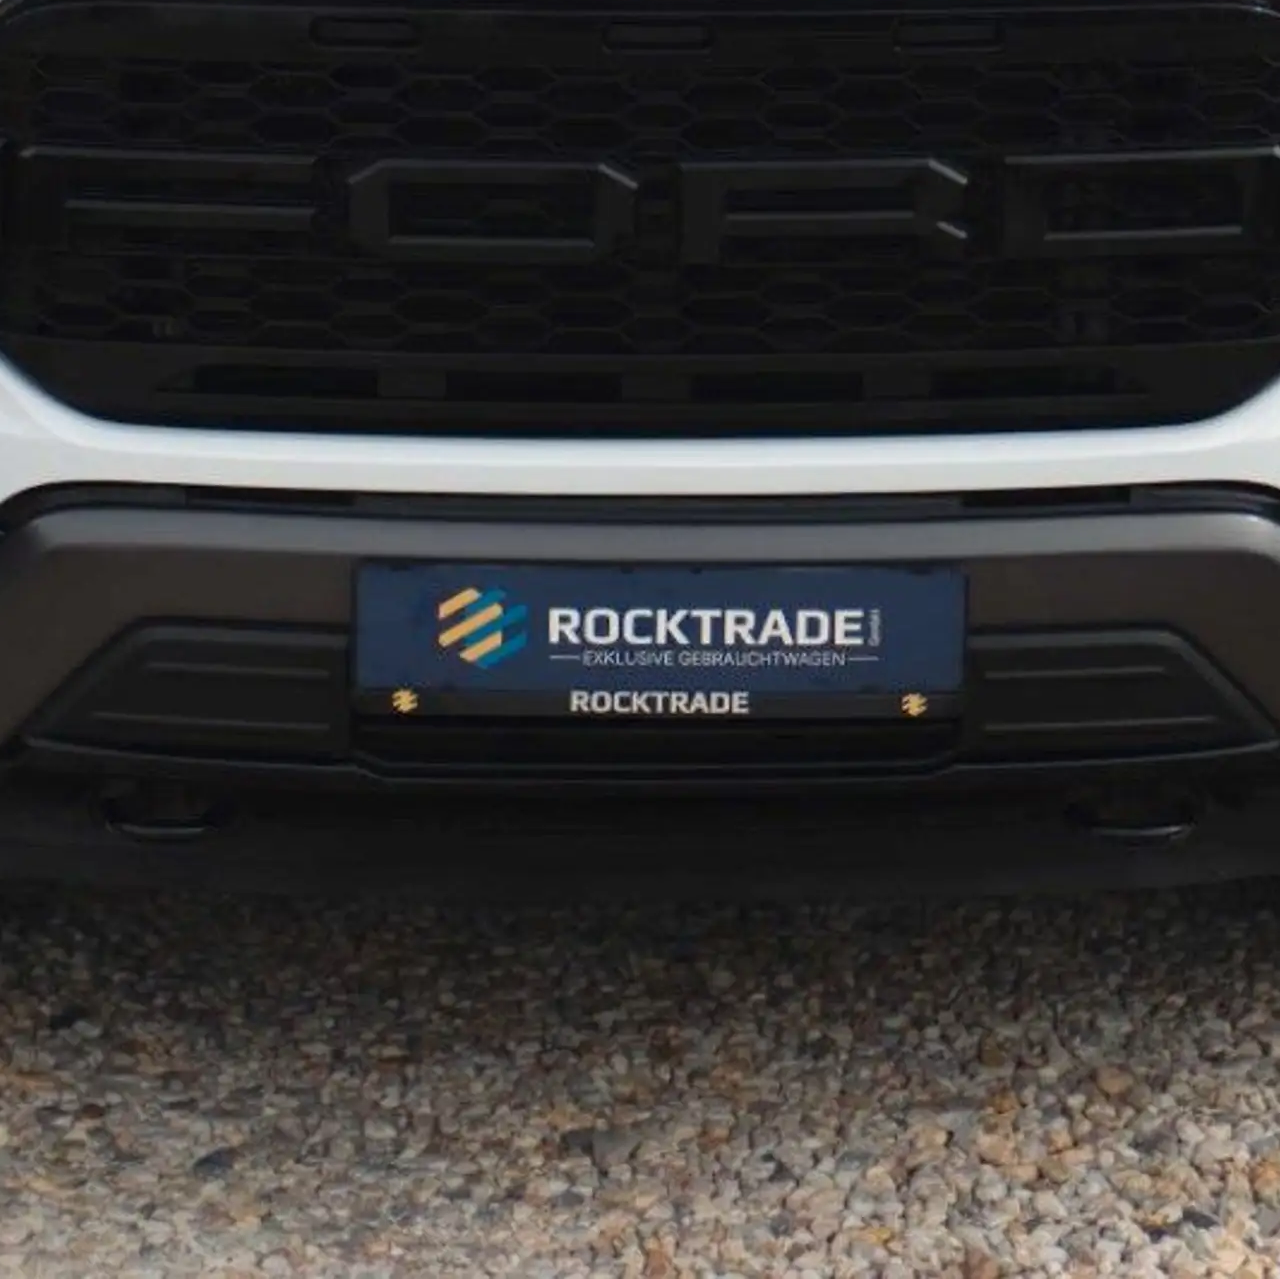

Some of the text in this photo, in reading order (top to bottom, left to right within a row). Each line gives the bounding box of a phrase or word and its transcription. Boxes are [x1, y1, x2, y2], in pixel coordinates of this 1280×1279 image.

[549, 608, 865, 646] ROCKTRADE
[582, 650, 846, 667] EXKLUSIVE GEBRAUCHTWAGEN
[570, 691, 750, 714] ROCKTRADE
